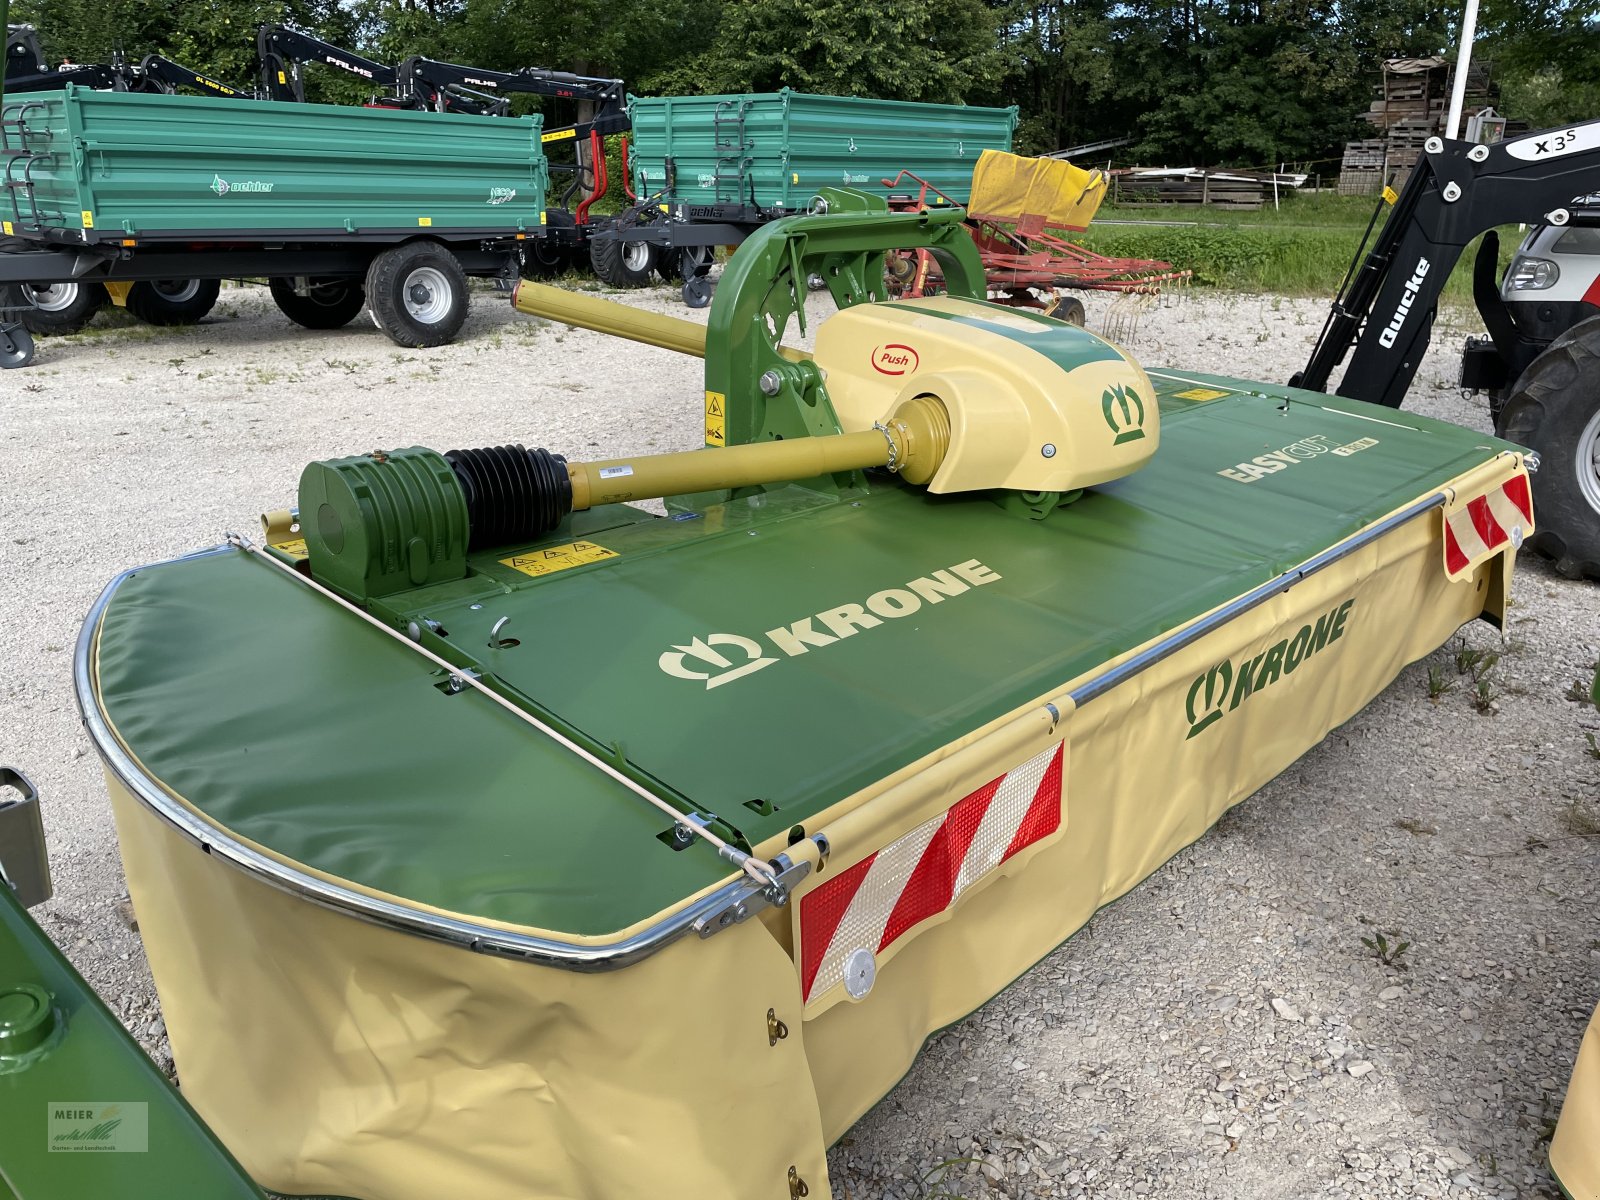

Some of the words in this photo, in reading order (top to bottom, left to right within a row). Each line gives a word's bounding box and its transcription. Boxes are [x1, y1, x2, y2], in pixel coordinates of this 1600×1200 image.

[326, 56, 373, 78] PALMS
[464, 77, 497, 87] PALMS
[230, 181, 274, 192] oehler
[1378, 257, 1430, 349] Quicke
[880, 353, 909, 366] Push
[764, 558, 1003, 657] KRONE
[1228, 598, 1355, 712] KRONE
